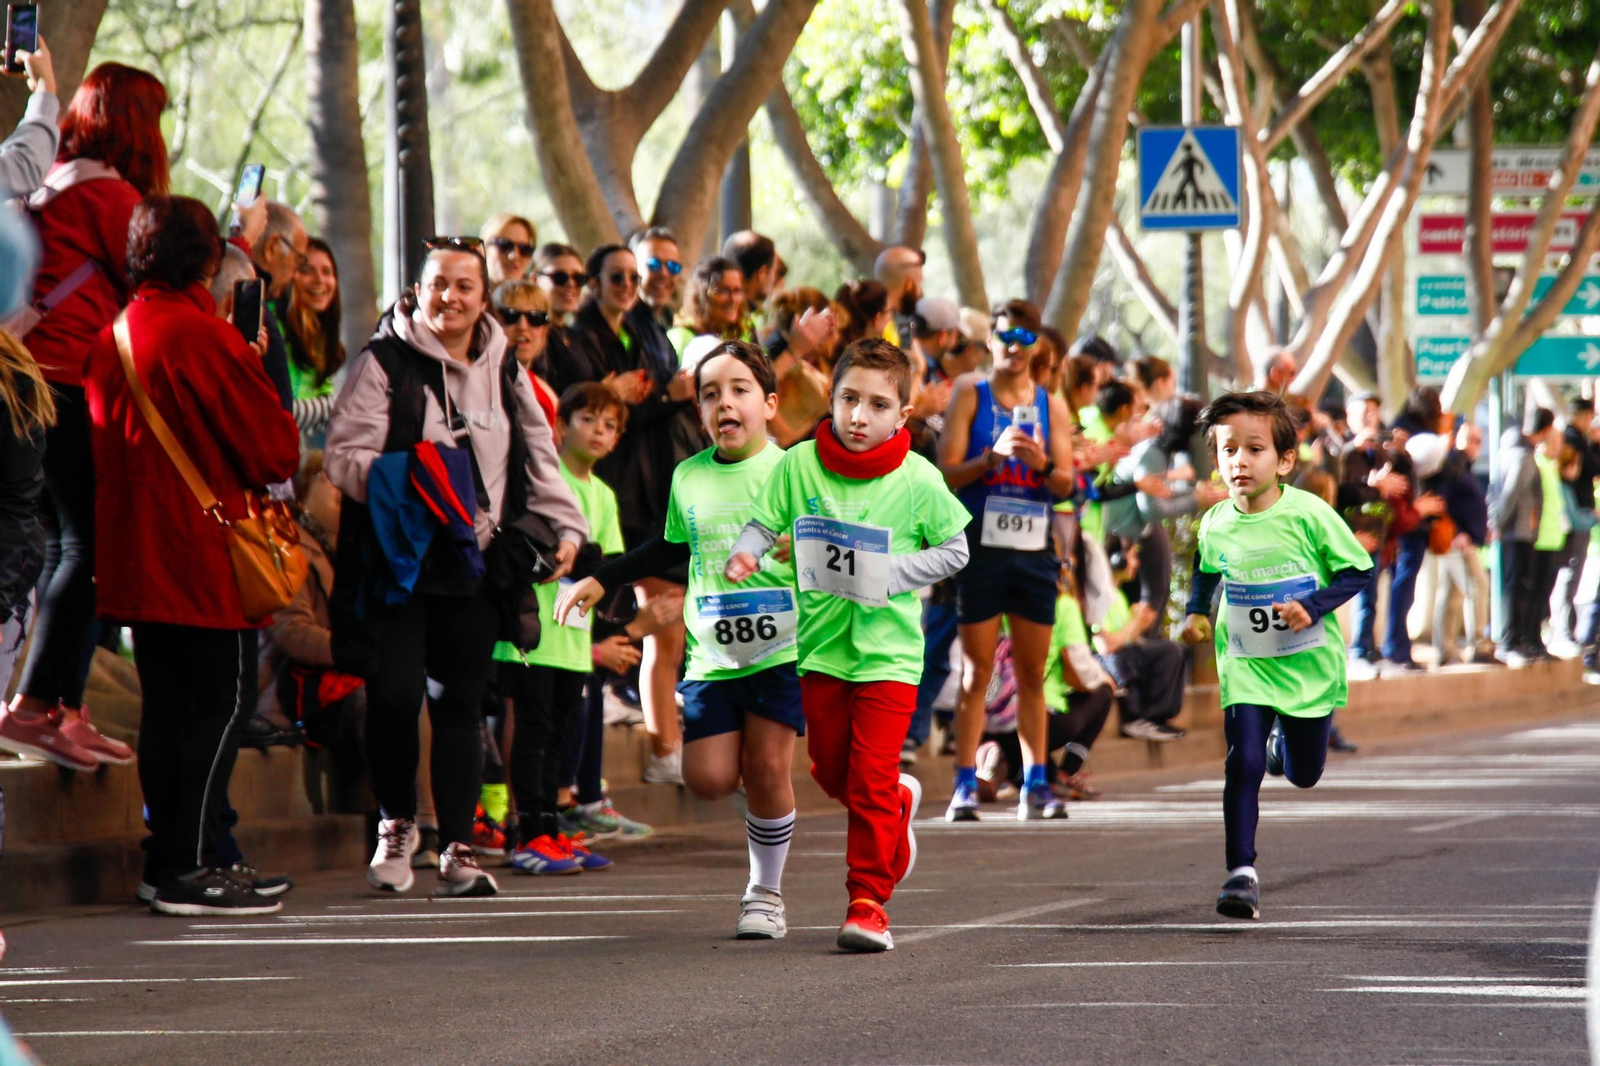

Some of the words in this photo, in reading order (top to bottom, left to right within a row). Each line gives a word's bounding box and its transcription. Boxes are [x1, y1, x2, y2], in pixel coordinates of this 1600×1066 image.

[798, 526, 821, 534] contra
[997, 514, 1033, 533] 691
[826, 544, 855, 577] 21
[1251, 560, 1307, 579] marcha
[714, 614, 778, 646] 886
[1249, 608, 1290, 634] 95
